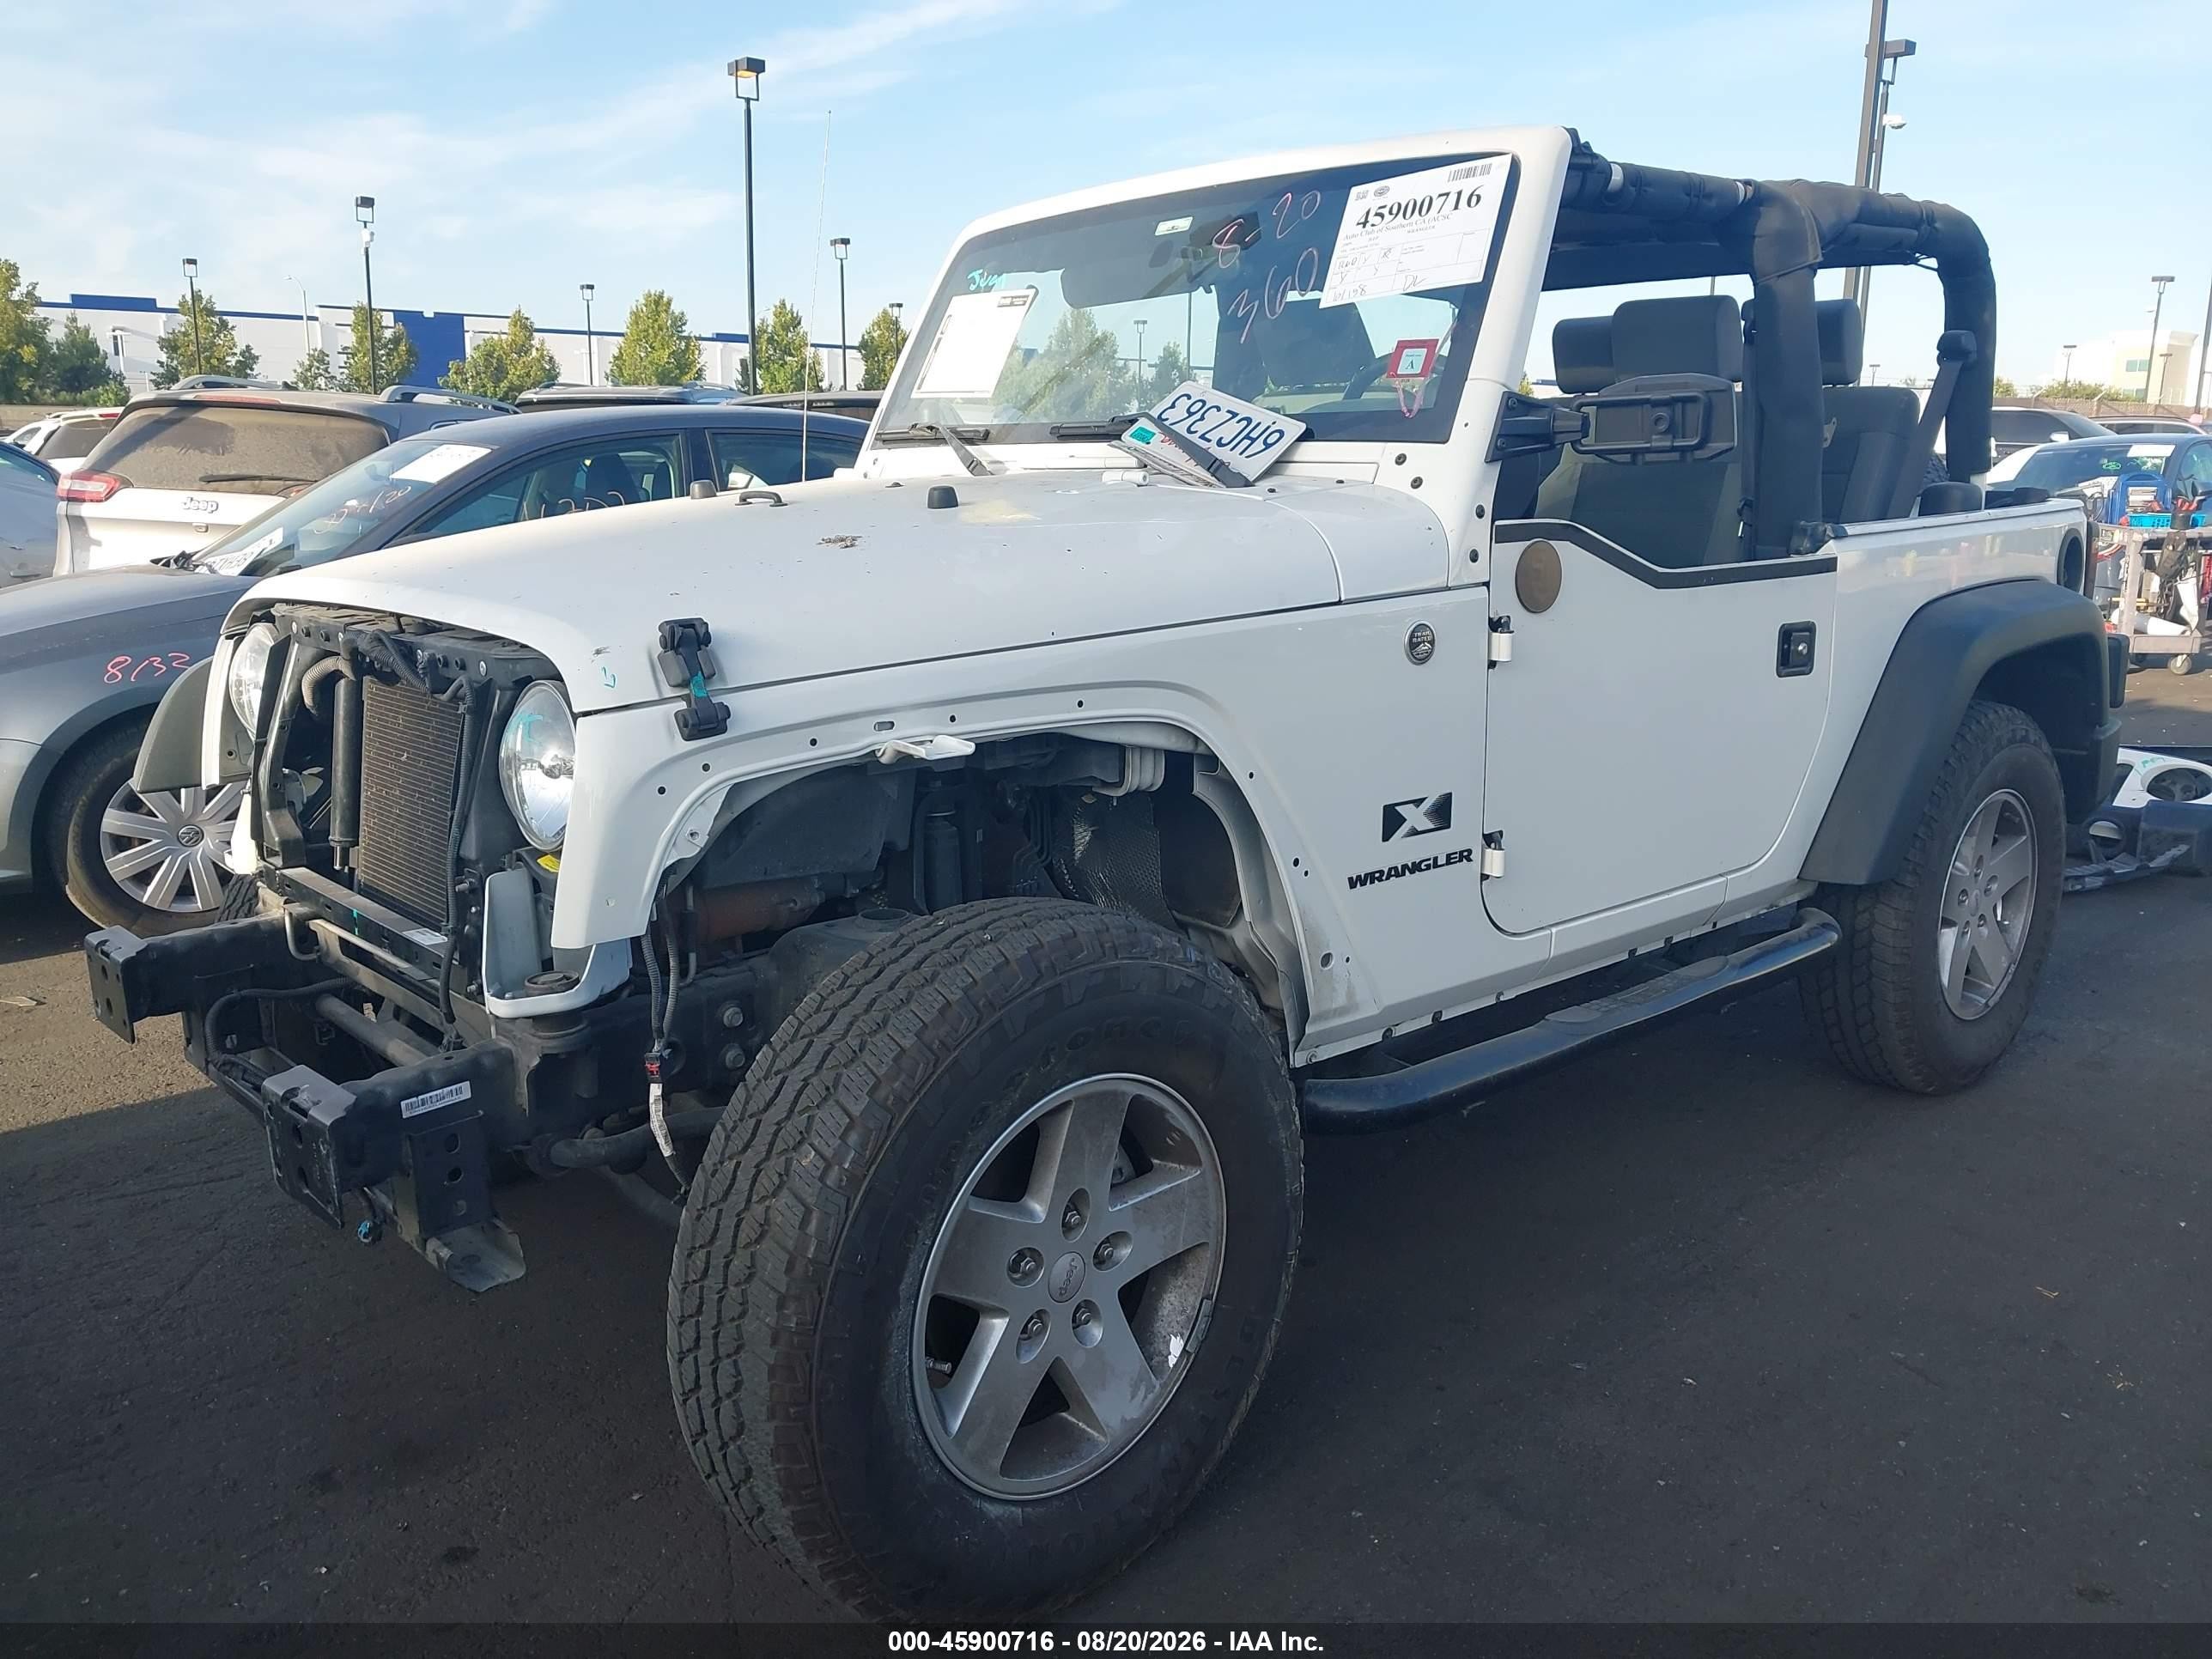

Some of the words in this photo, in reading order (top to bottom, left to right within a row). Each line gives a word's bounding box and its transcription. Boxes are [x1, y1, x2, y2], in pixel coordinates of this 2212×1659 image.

[1356, 184, 1485, 228] 45900716
[1385, 220, 1413, 232] Southern
[1157, 393, 1285, 459] 6HCZ363
[179, 496, 220, 514] Jeep
[1346, 848, 1474, 890] WRANGLER
[1058, 1257, 1078, 1297] Jeep
